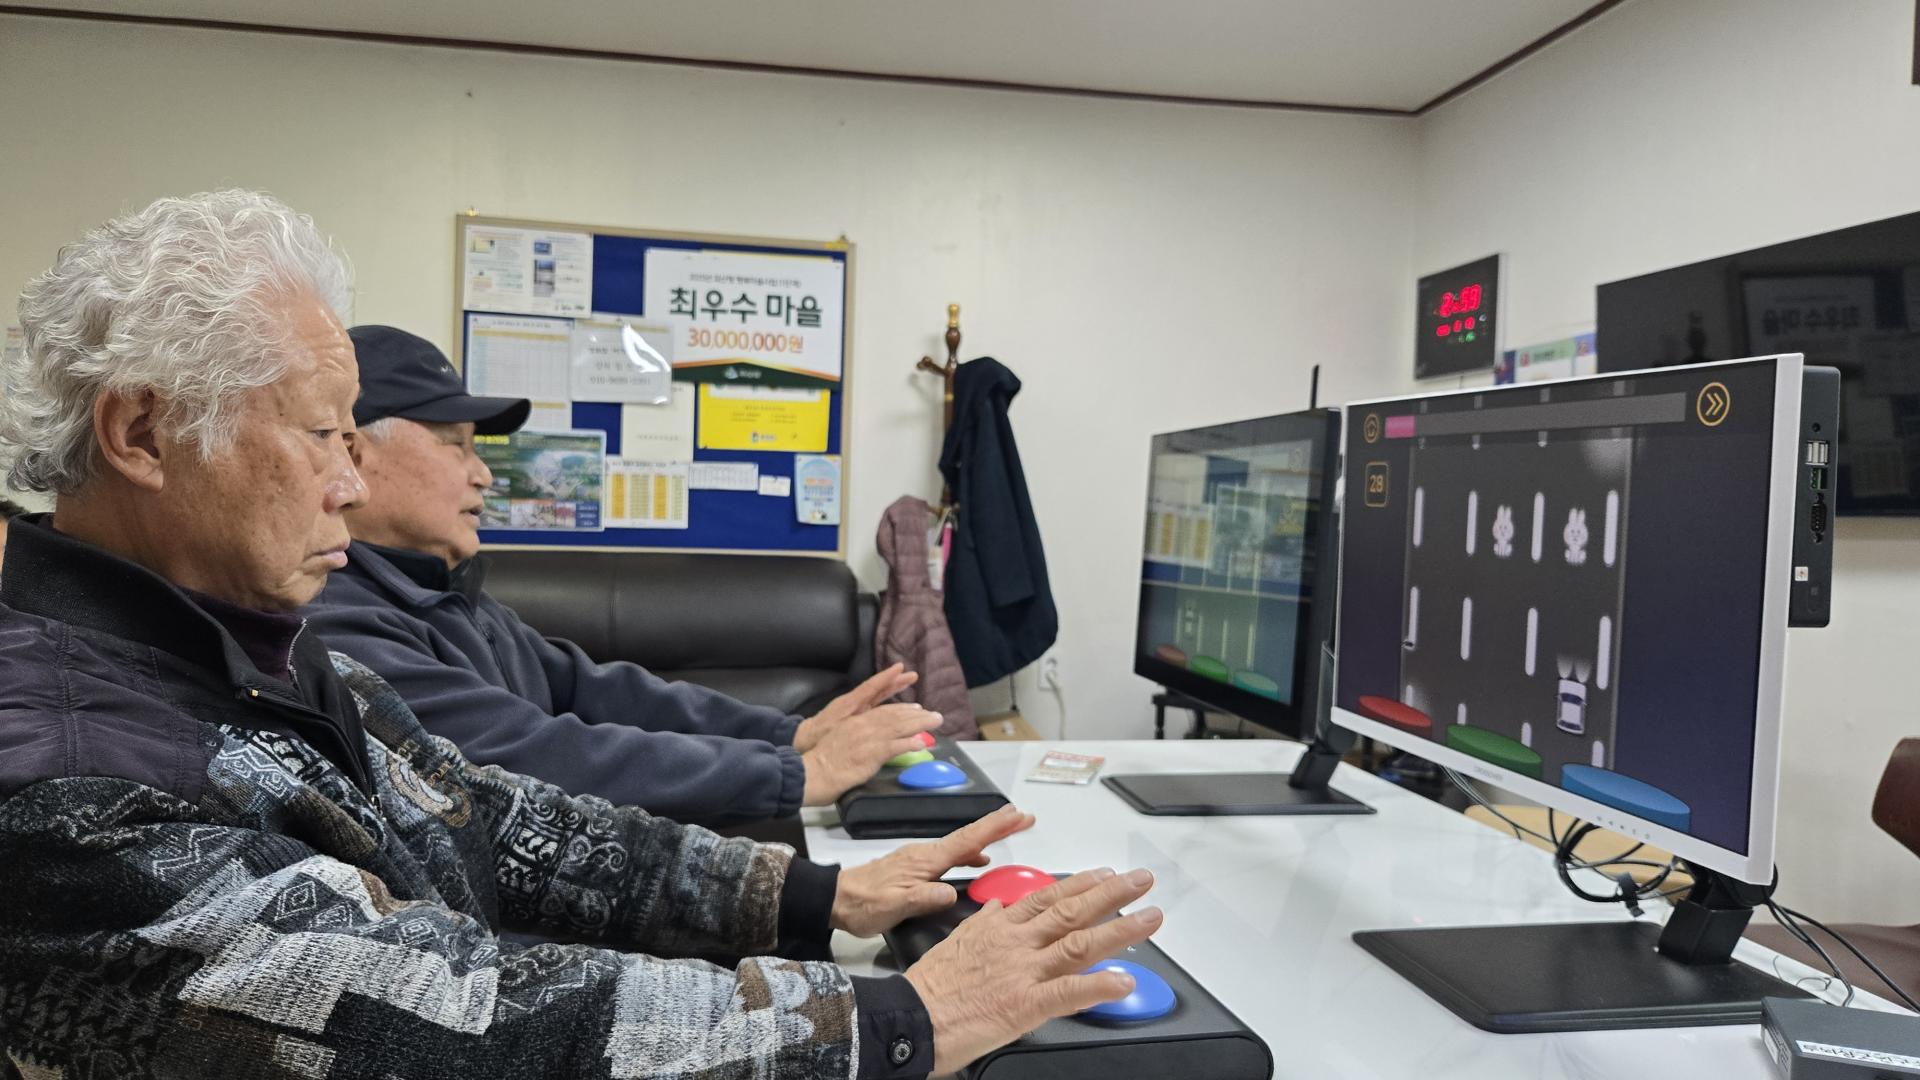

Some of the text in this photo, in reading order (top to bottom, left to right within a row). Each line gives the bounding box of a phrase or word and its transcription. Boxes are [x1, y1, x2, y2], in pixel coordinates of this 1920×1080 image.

[670, 286, 822, 327] 최우수 마을
[687, 328, 804, 353] 30,000,000원
[1370, 474, 1384, 492] 28
